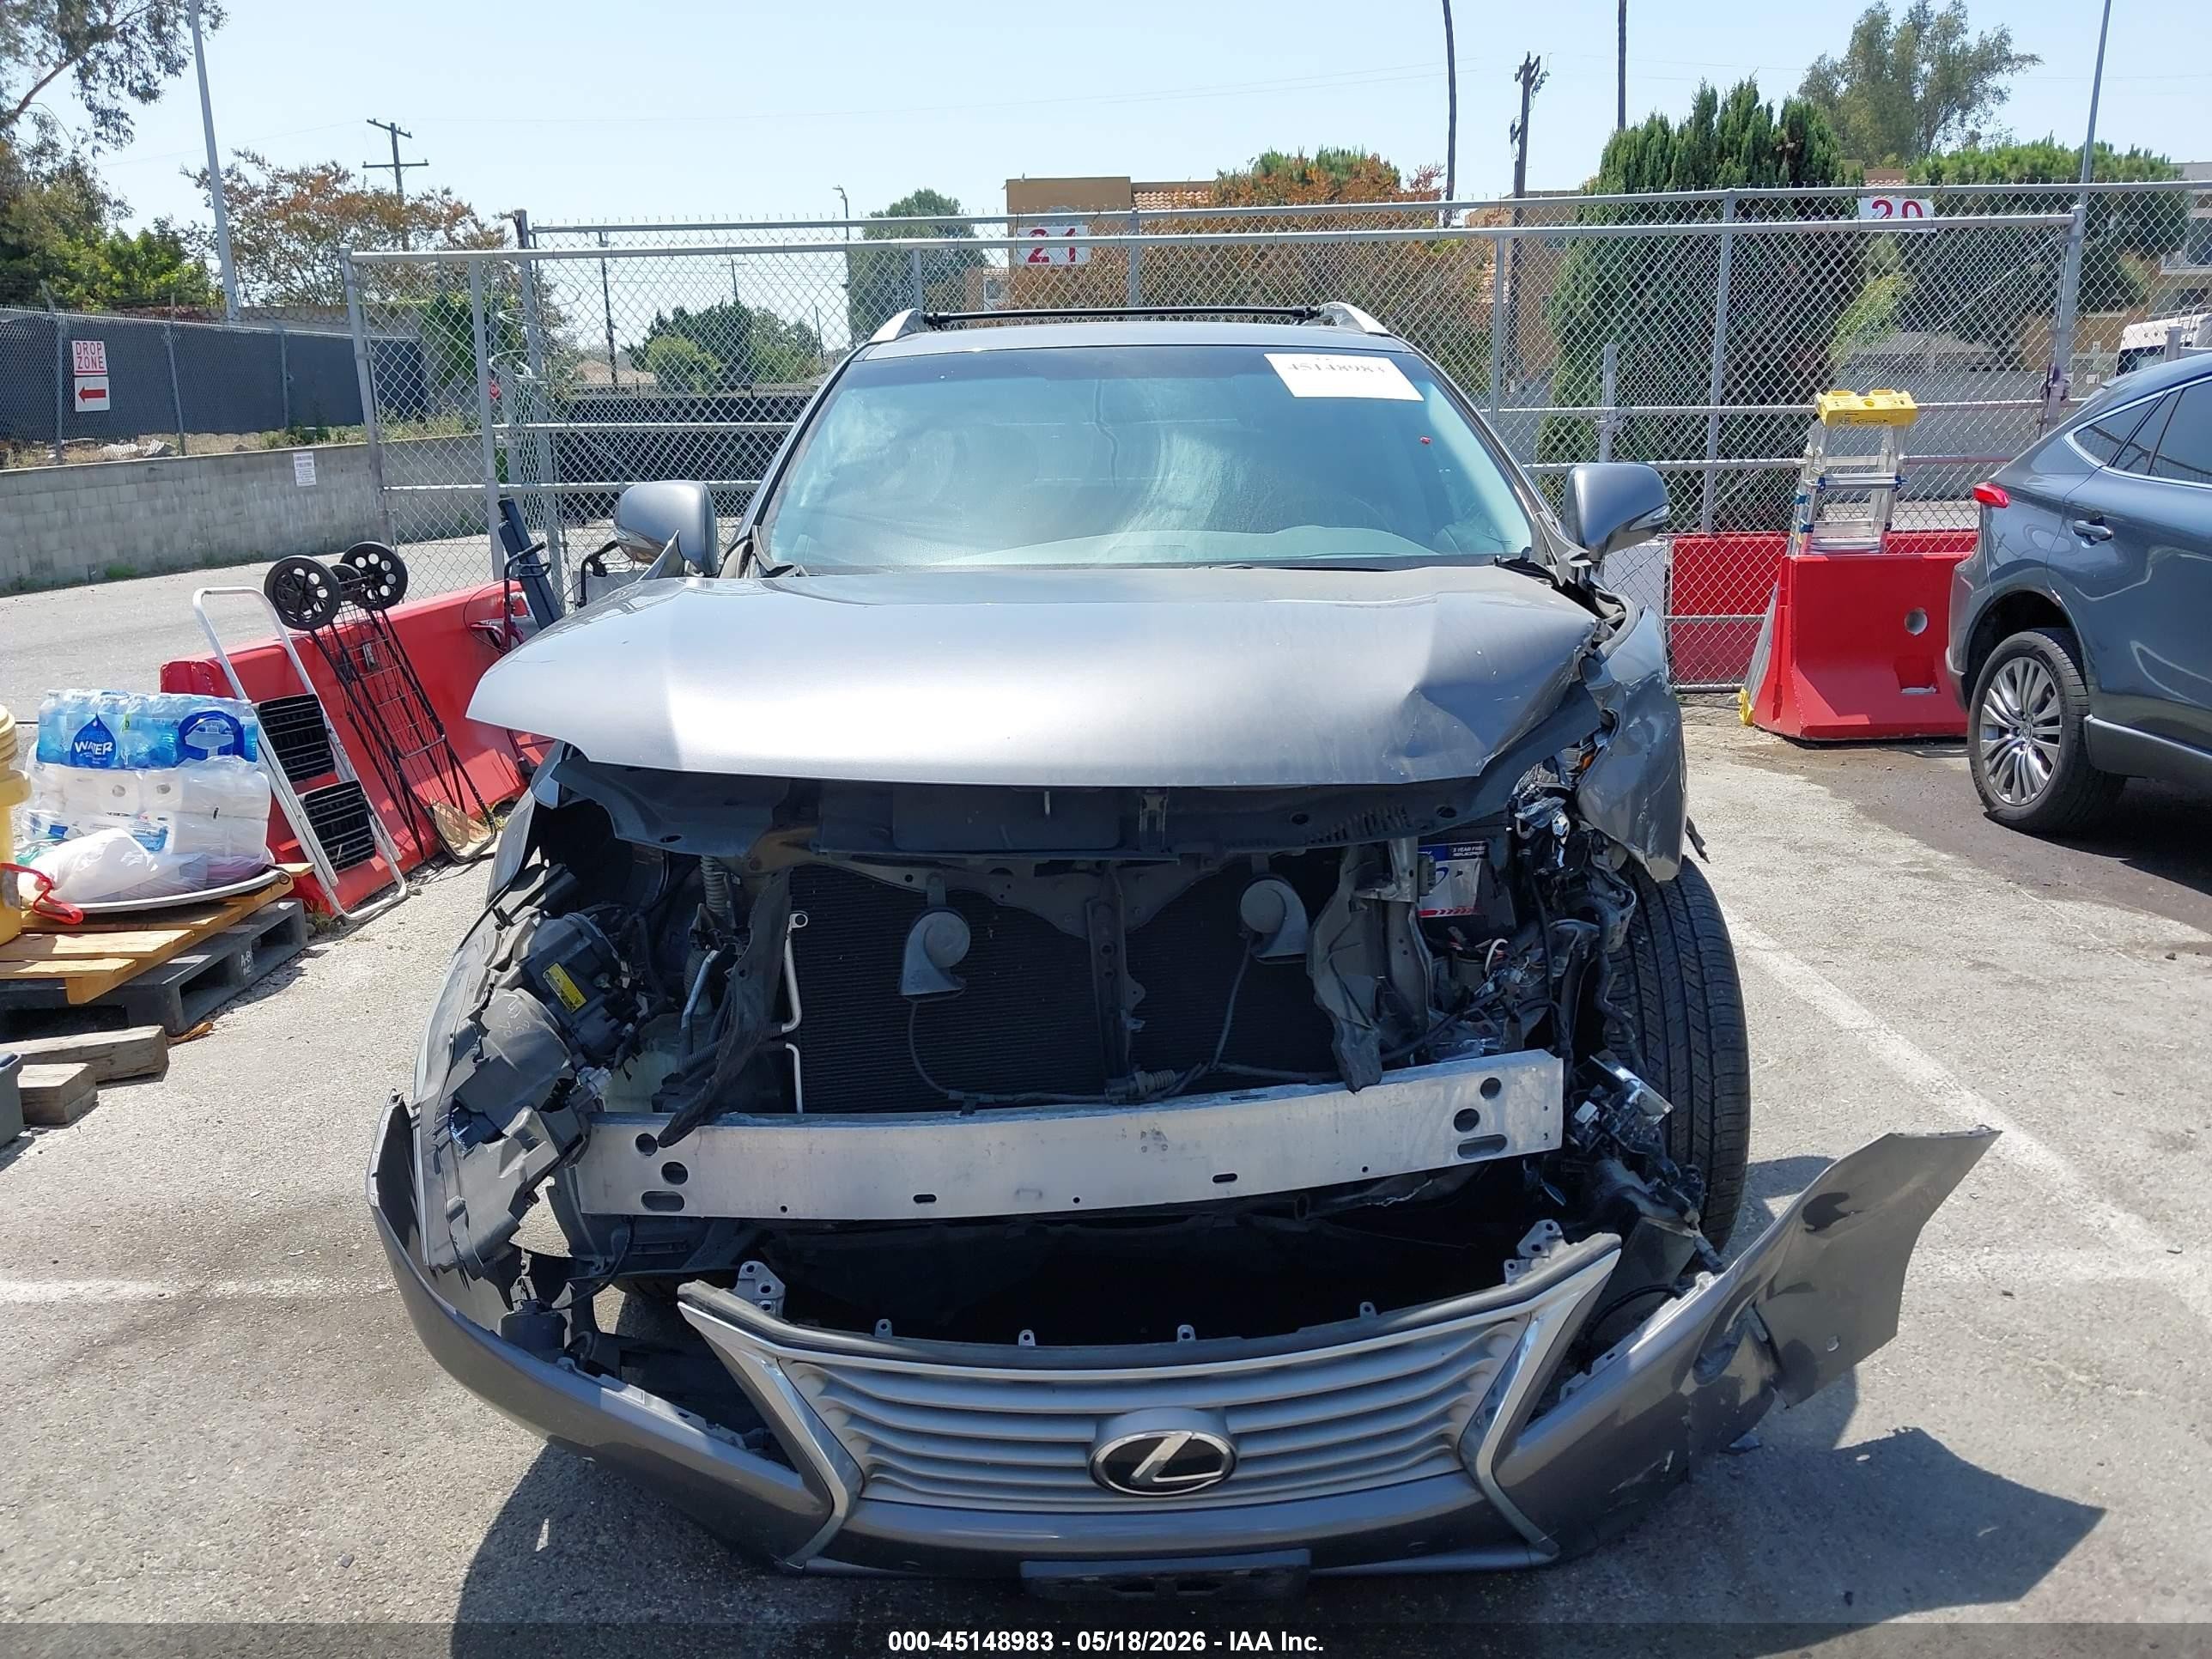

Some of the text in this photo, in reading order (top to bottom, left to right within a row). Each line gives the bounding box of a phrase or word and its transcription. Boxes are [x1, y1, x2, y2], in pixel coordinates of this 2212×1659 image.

[1027, 228, 1076, 263] 21
[76, 342, 102, 356] DROP
[77, 356, 105, 369] ZONE
[74, 740, 113, 756] WATER
